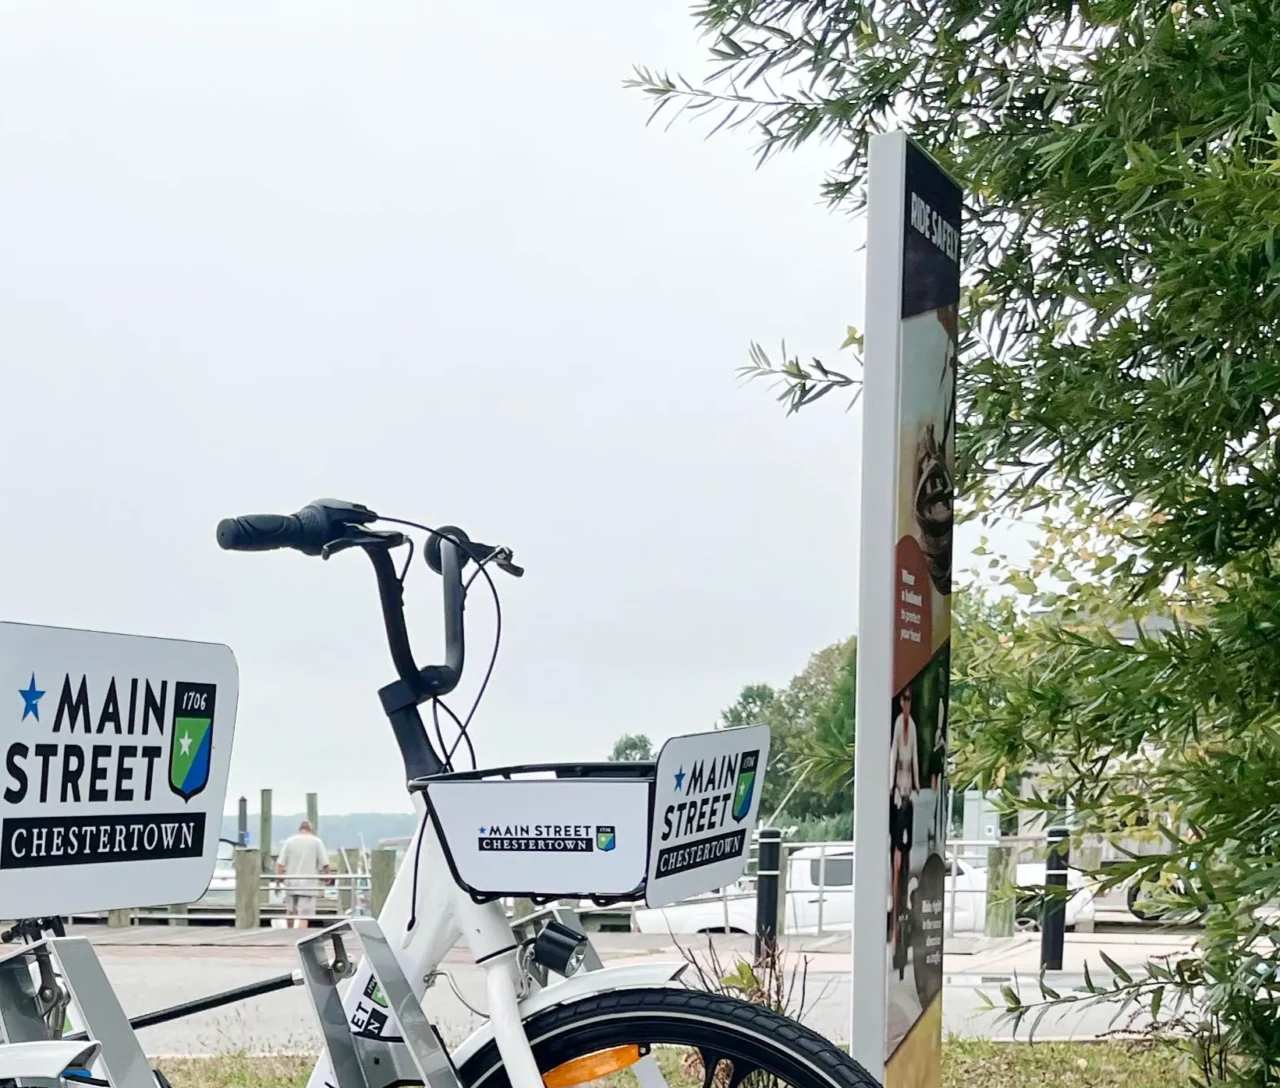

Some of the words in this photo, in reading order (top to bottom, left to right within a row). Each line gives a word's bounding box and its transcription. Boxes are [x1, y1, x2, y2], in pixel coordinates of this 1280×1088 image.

[910, 191, 930, 240] RIDE
[931, 210, 959, 263] SAFELY
[52, 672, 168, 736] MAIN
[182, 691, 207, 711] 1706
[3, 741, 162, 804] STREET
[685, 753, 739, 797] MAIN
[489, 825, 529, 836] MAIN
[535, 825, 591, 837] STREET
[661, 792, 732, 841] STREET
[11, 822, 195, 858] CHESTERTOWN
[482, 839, 587, 850] CHESTERTOWN
[659, 835, 742, 872] CHESTERTOWN
